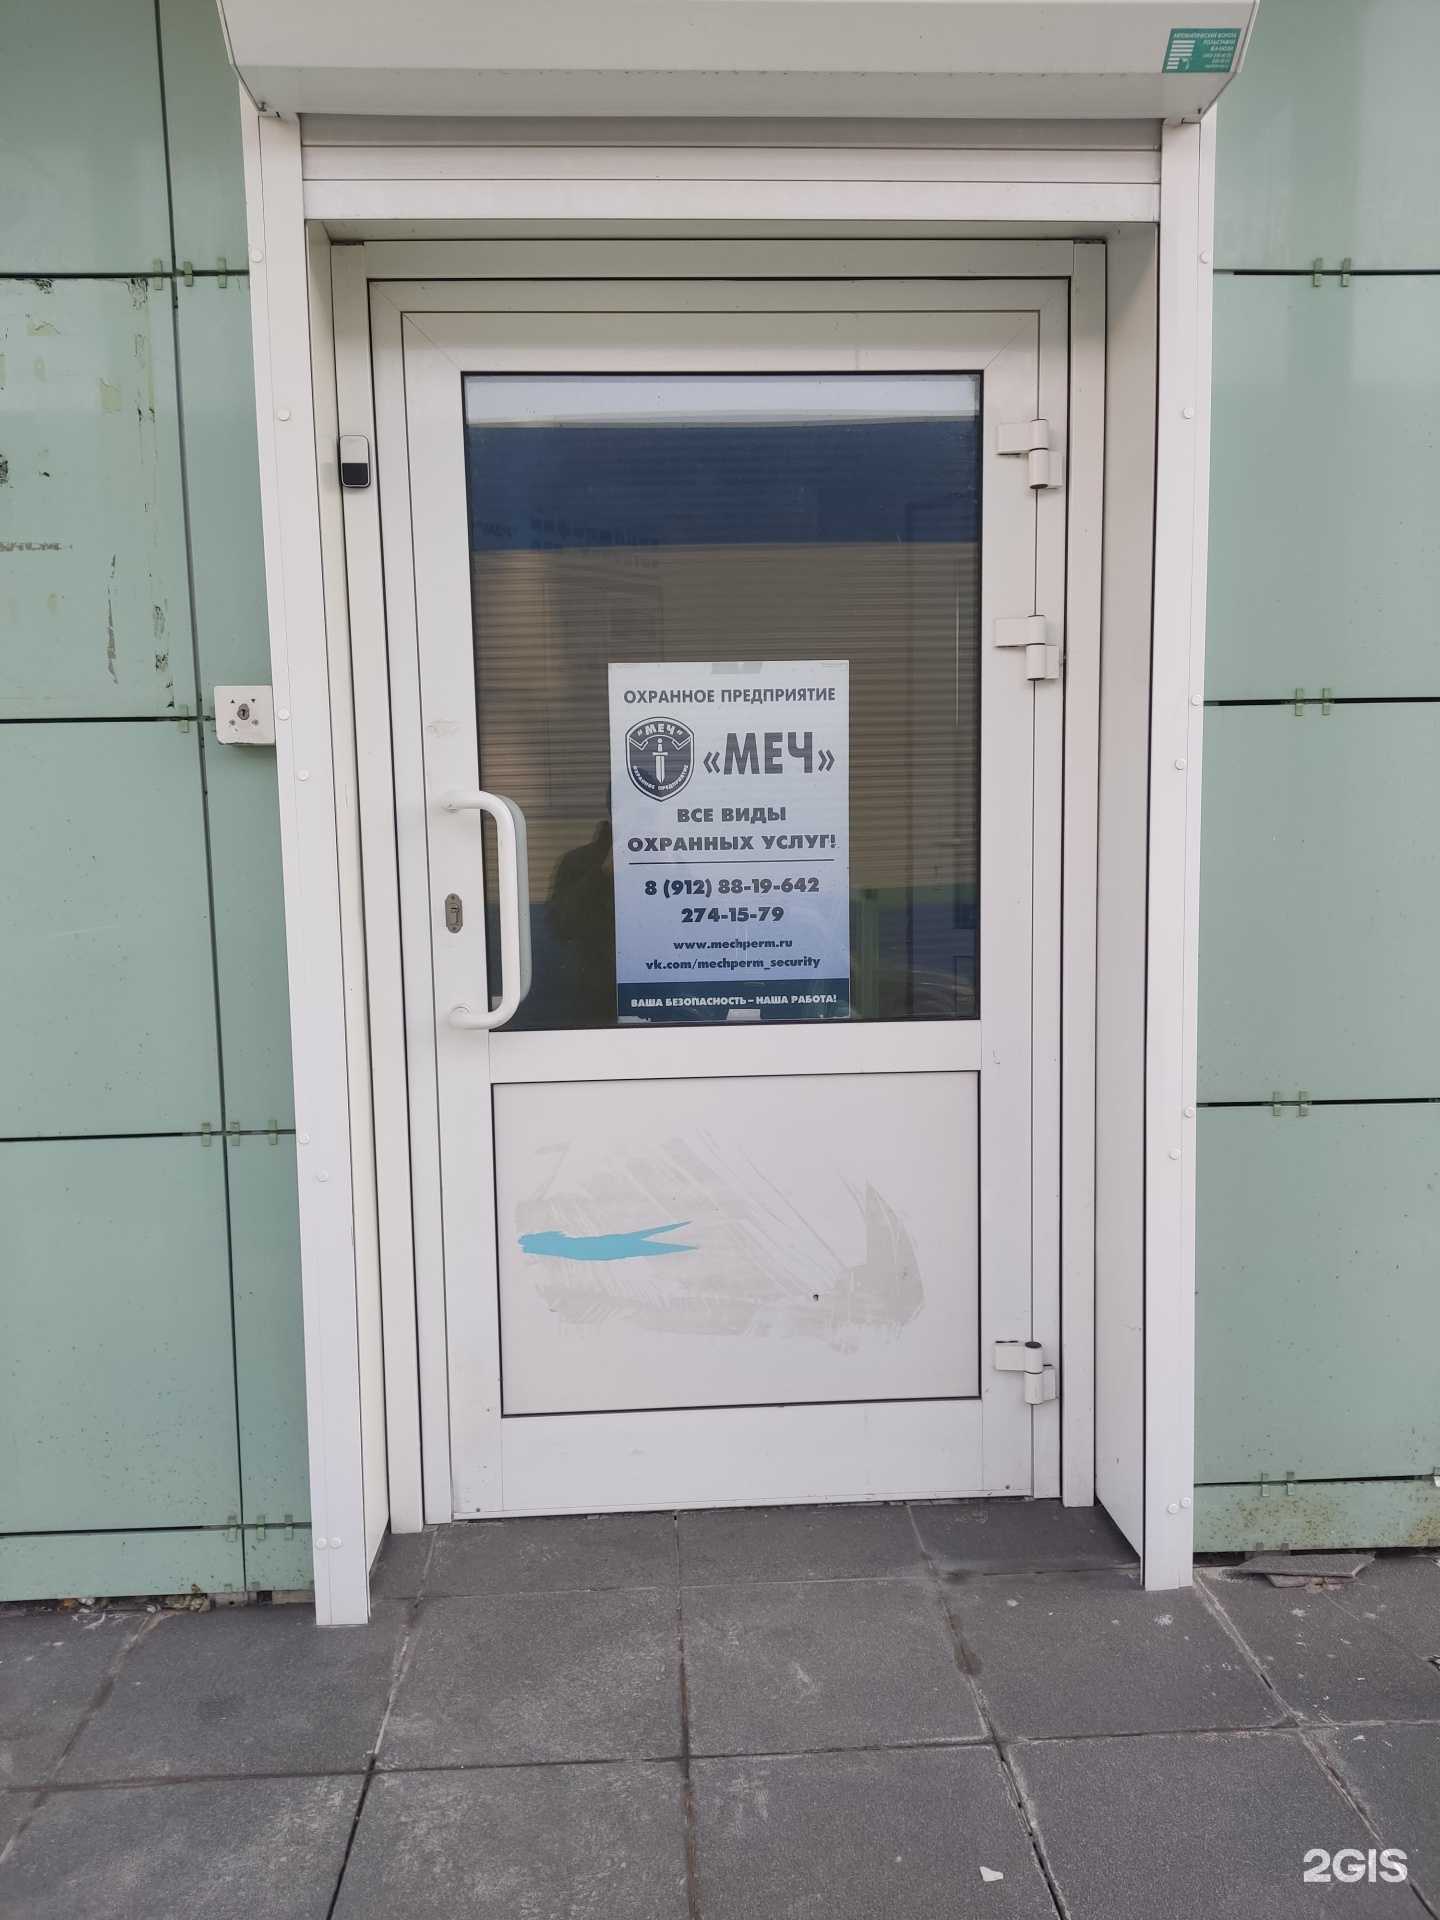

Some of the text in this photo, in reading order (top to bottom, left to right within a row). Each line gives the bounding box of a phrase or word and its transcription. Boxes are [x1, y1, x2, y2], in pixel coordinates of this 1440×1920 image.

[624, 687, 836, 704] ОХРАННОЕ ПРЕДПРИЯТИЕ
[703, 731, 836, 775] «МЕЧ»
[677, 806, 787, 824] ВСЕ ВИДЫ
[627, 834, 836, 852] ОХРАННЫХ УСЛУГ!
[644, 877, 820, 898] 8 (912) 88-19-642
[681, 906, 785, 923] 274-15-79
[673, 938, 793, 951] www.mechperm.ru
[645, 956, 821, 971] vk.com/mechperm_security
[631, 998, 663, 1008] ВАША
[665, 996, 746, 1007] БЕЗОПАСНОСТЬ
[755, 995, 788, 1006] НАША
[791, 994, 837, 1004] РАБОТА!
